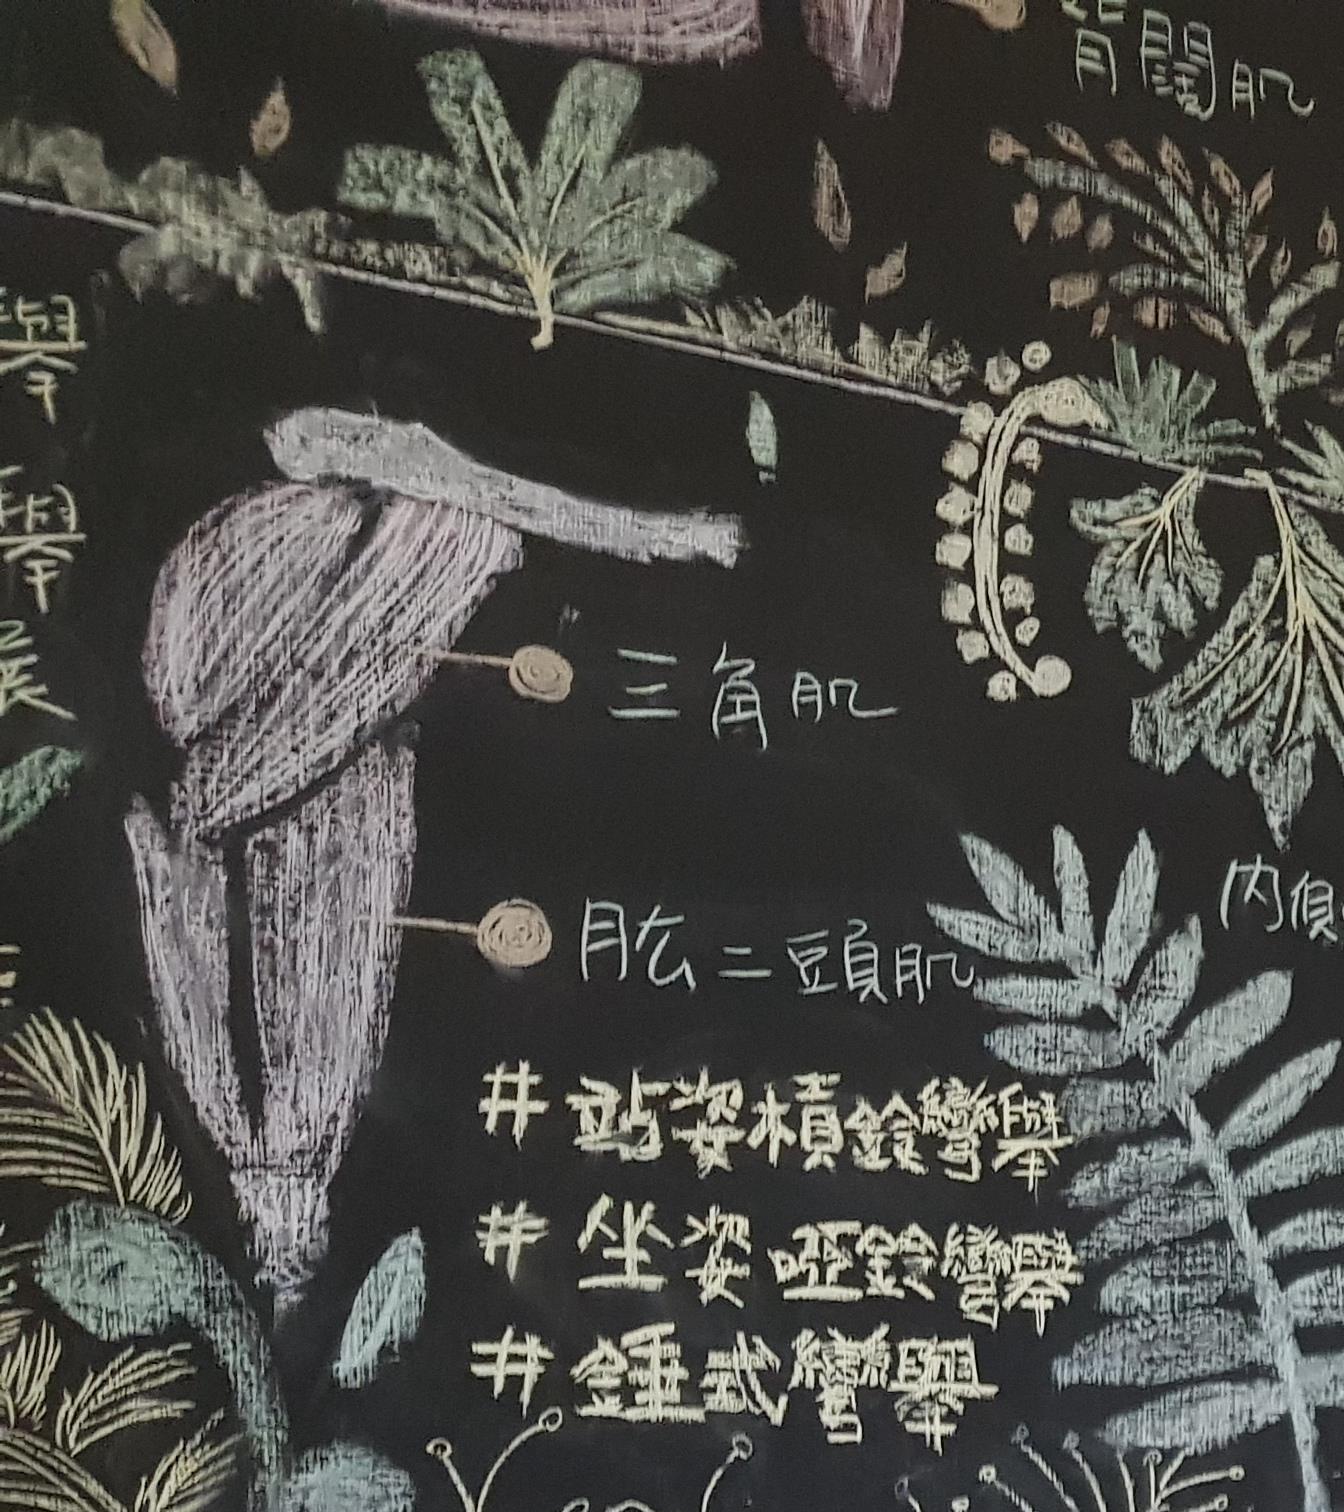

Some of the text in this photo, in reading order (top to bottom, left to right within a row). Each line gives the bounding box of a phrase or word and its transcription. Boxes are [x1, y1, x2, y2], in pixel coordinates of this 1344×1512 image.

[606, 640, 899, 752] 三角肌
[578, 896, 976, 1006] 肱二頭肌
